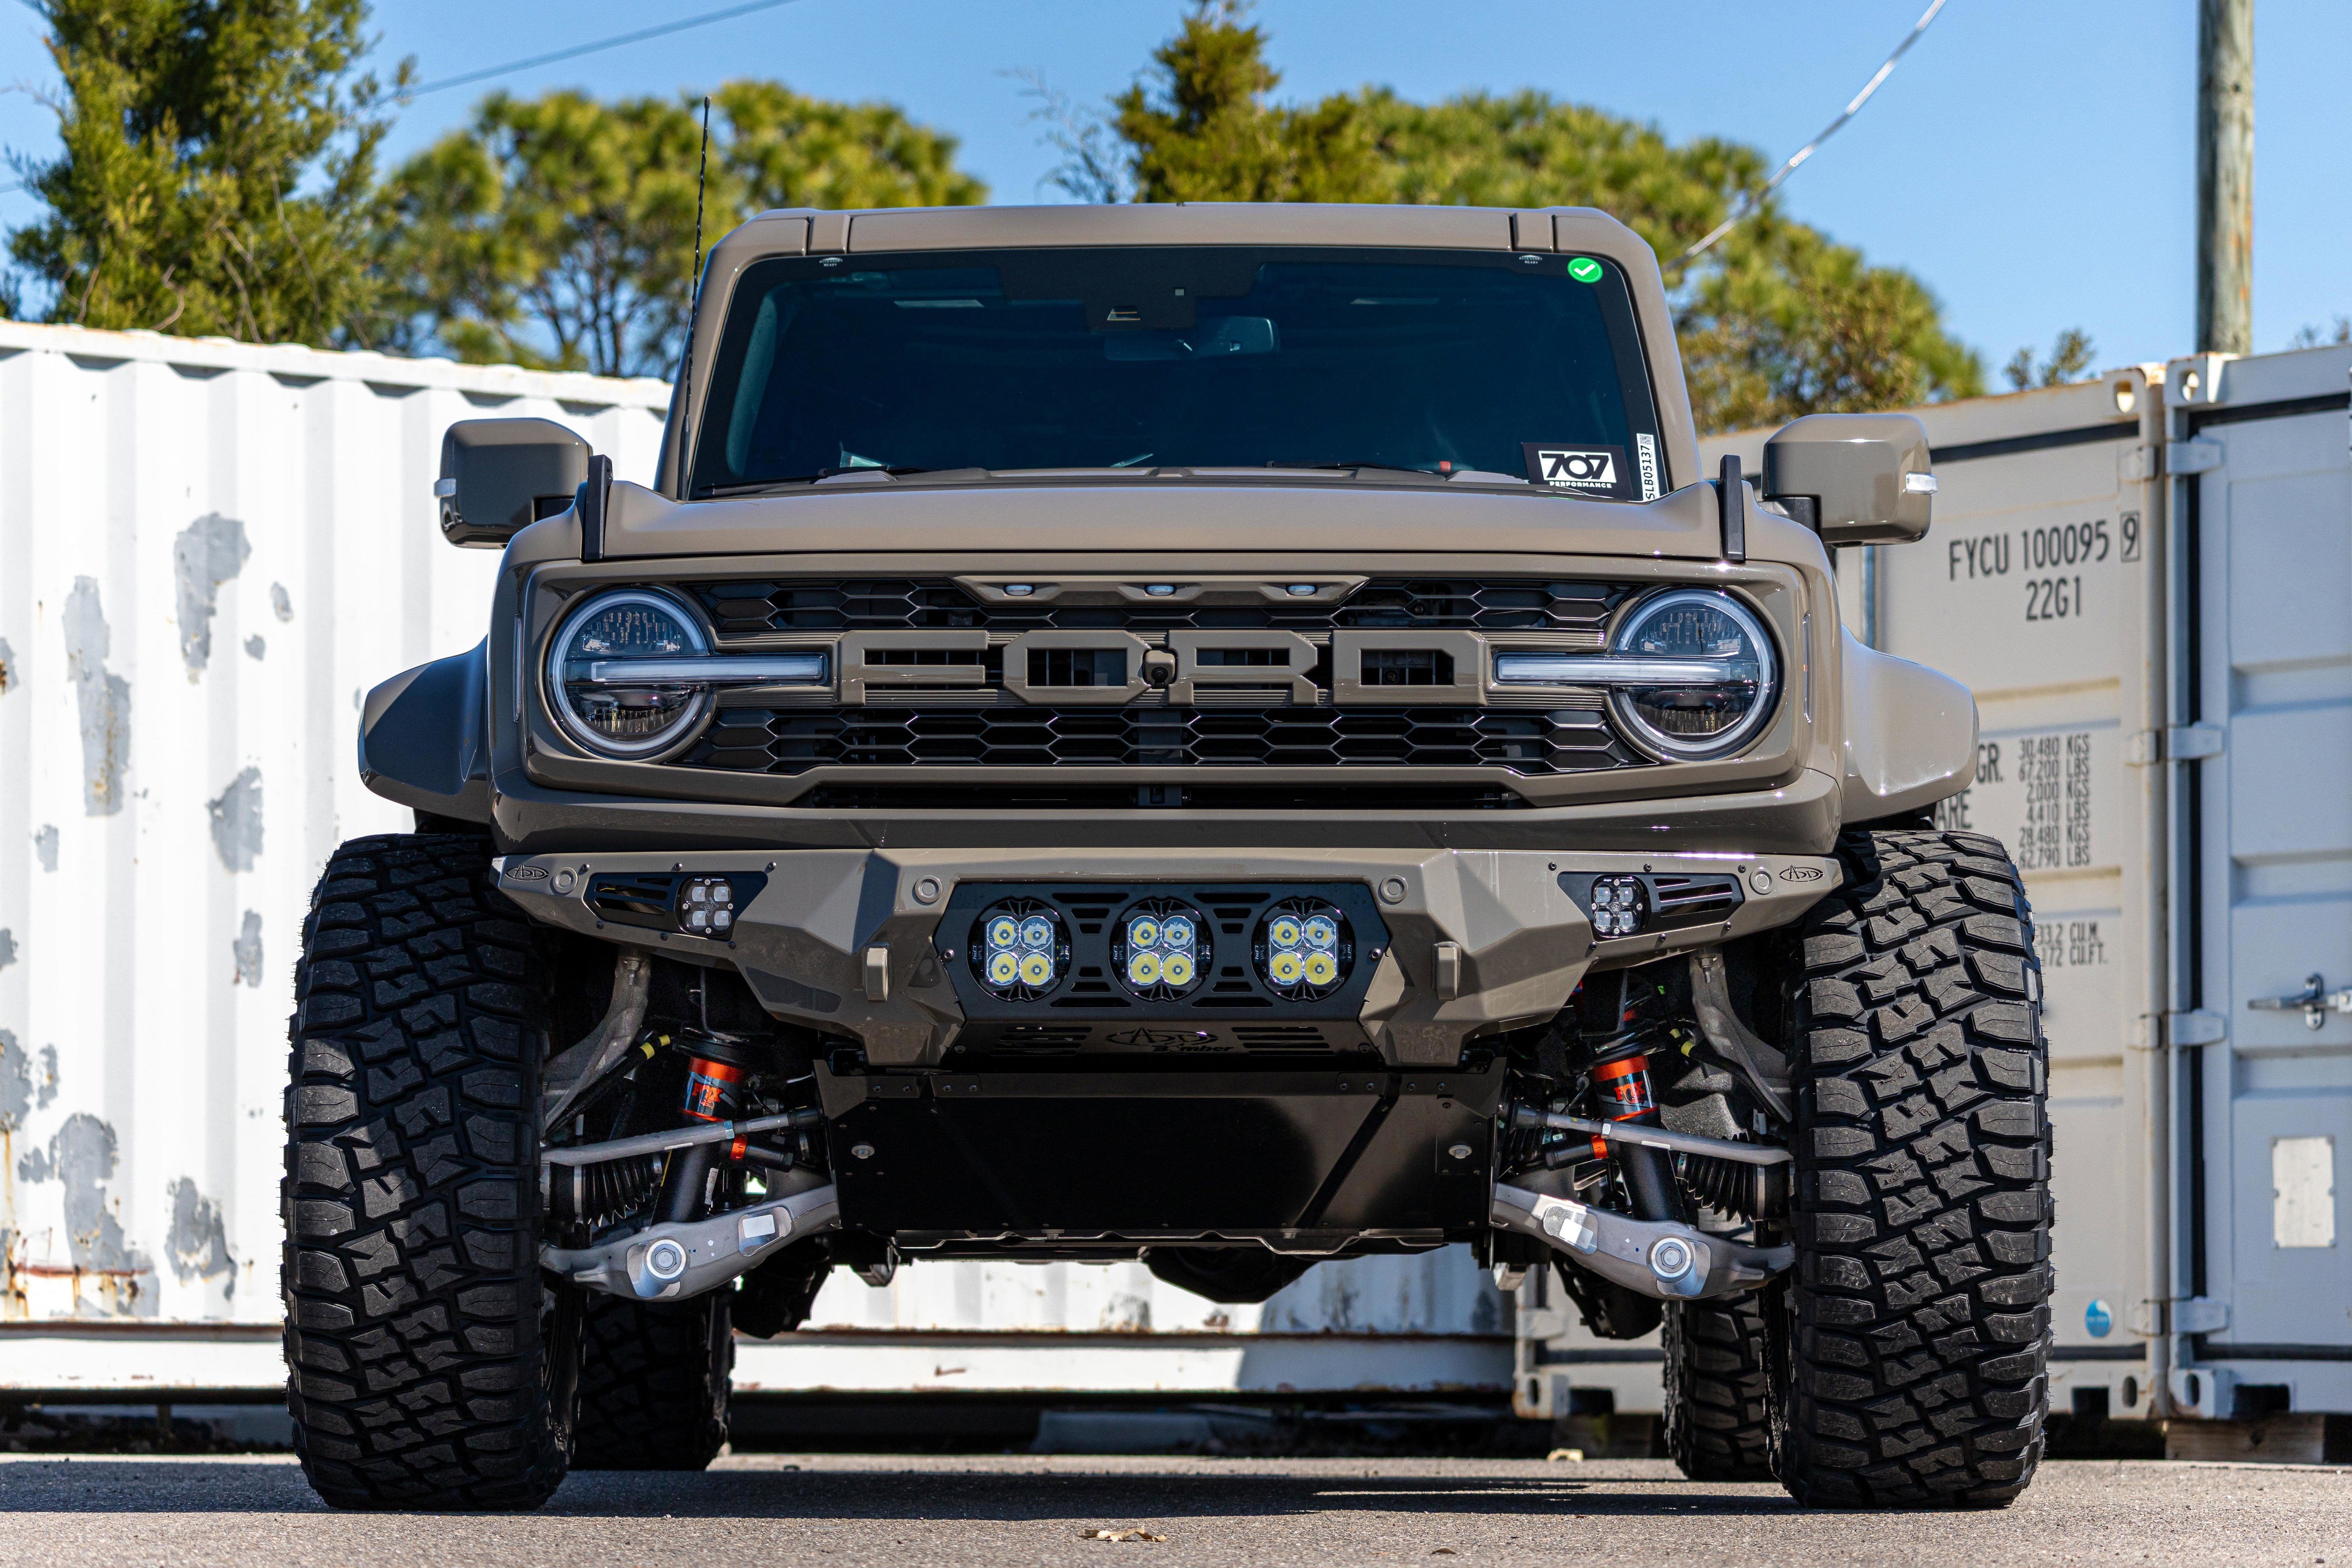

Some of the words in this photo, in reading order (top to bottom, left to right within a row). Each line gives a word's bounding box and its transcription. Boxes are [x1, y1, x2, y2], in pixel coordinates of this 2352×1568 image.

[1541, 453, 1609, 479] 707
[1640, 445, 1655, 501] SLB05137
[1949, 532, 2009, 581] FYCU
[2021, 519, 2109, 570] 100095
[2123, 516, 2138, 557] 9
[2025, 575, 2080, 622] 22G1
[835, 629, 1489, 706] FORD
[2067, 734, 2089, 755] KGS
[2067, 757, 2089, 778] LBS
[2067, 779, 2089, 799] KGS
[1937, 788, 1972, 831] ARE
[2067, 801, 2089, 822] LBS
[2067, 823, 2089, 844] KGS
[2067, 845, 2089, 867] LBS
[1614, 1081, 1646, 1104] FOX
